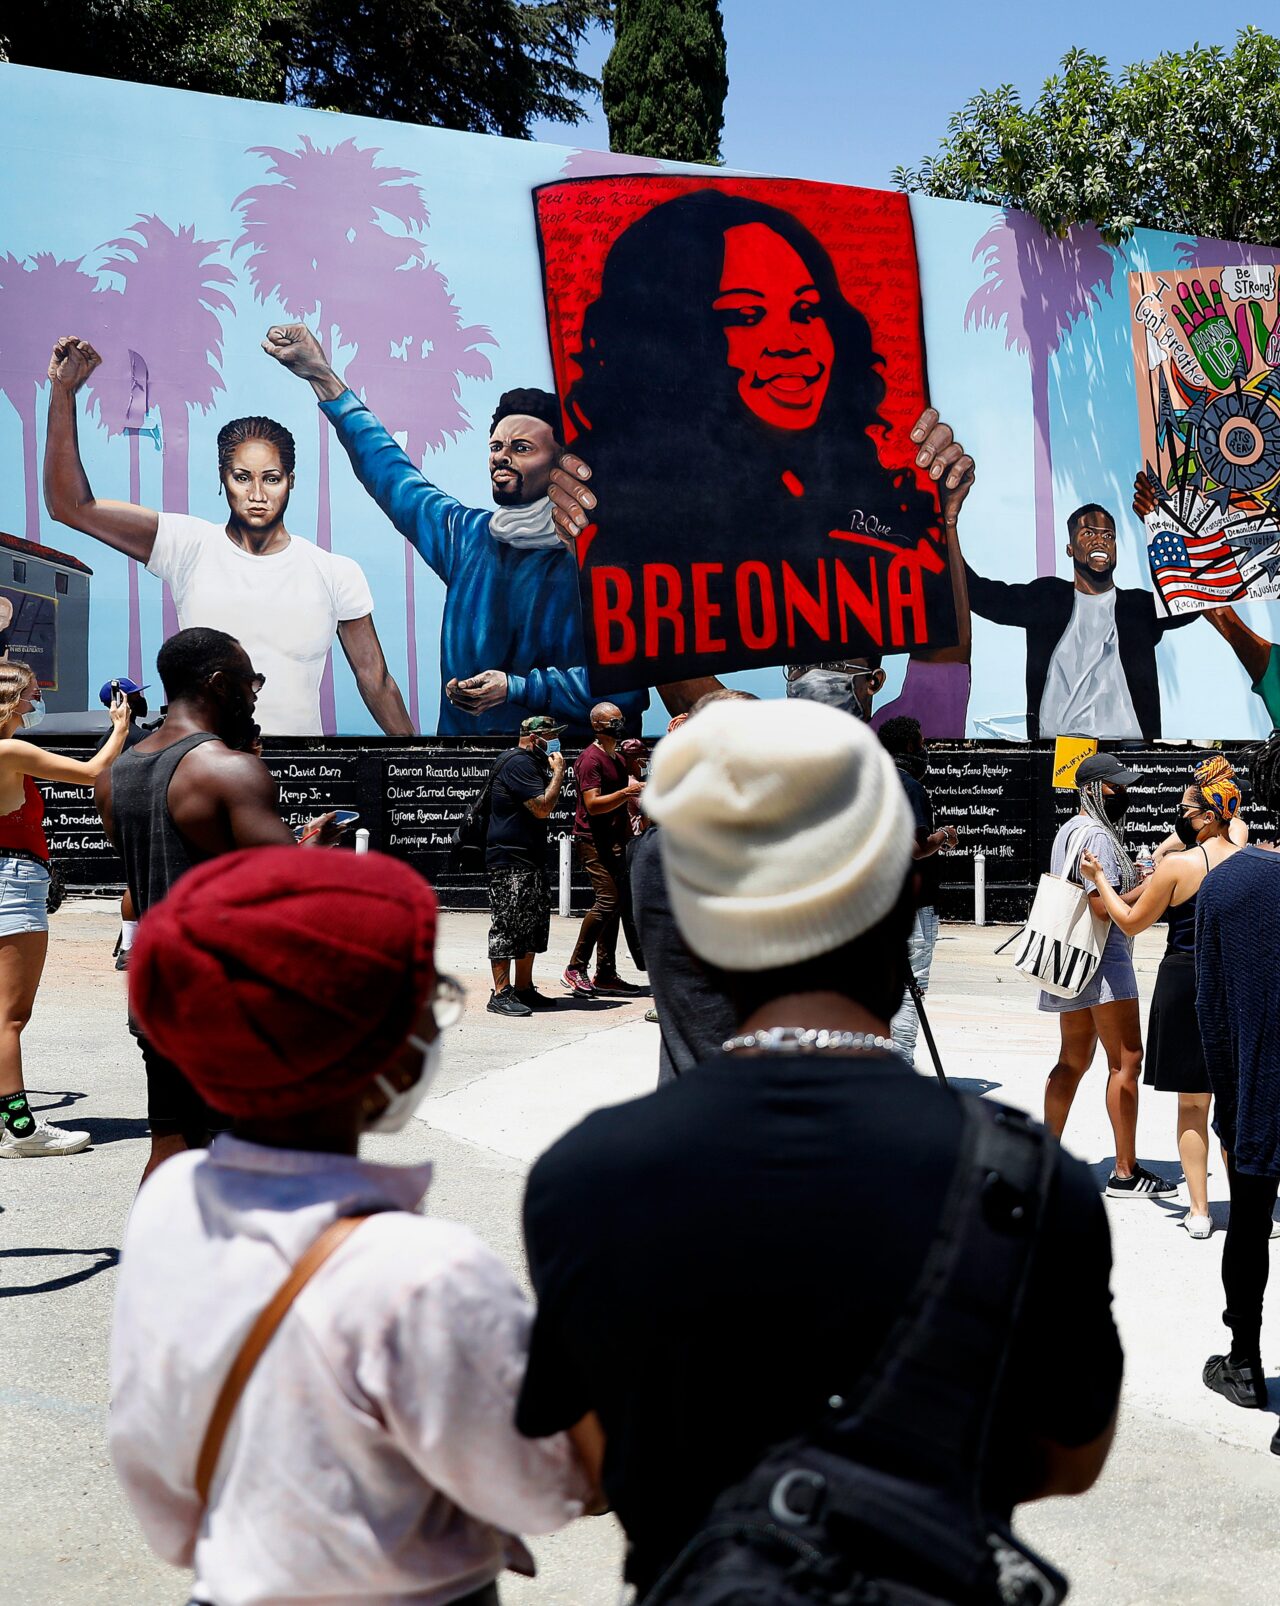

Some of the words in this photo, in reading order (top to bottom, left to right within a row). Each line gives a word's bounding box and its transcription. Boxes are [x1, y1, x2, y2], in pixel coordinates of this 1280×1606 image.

[577, 190, 607, 207] Stop
[571, 209, 624, 232] Killing
[1236, 268, 1251, 280] Be
[1153, 277, 1171, 303] I
[1192, 319, 1232, 354] HANDS
[1160, 328, 1206, 385] Breathe
[1205, 339, 1239, 379] UP
[1229, 440, 1253, 453] REAL
[1188, 502, 1211, 530] Prejudice
[1202, 512, 1242, 535] Transgression
[1148, 519, 1180, 533] inequity
[1227, 522, 1258, 538] Demonized
[590, 549, 928, 665] BREONNA
[1173, 599, 1205, 612] Racism
[289, 764, 316, 778] David
[319, 765, 342, 778] Dorn
[425, 764, 459, 778] Ricardo
[1054, 755, 1081, 778] AMPLIFY
[279, 785, 307, 804] Kemp
[387, 786, 415, 799] Oliver
[416, 785, 446, 798] Jarrod
[934, 785, 957, 795] Charles
[386, 808, 416, 826] Tyrone
[940, 805, 968, 816] Matthew
[969, 804, 996, 816] Walker
[1000, 825, 1023, 836] Rhodes
[389, 834, 428, 848] Dominique
